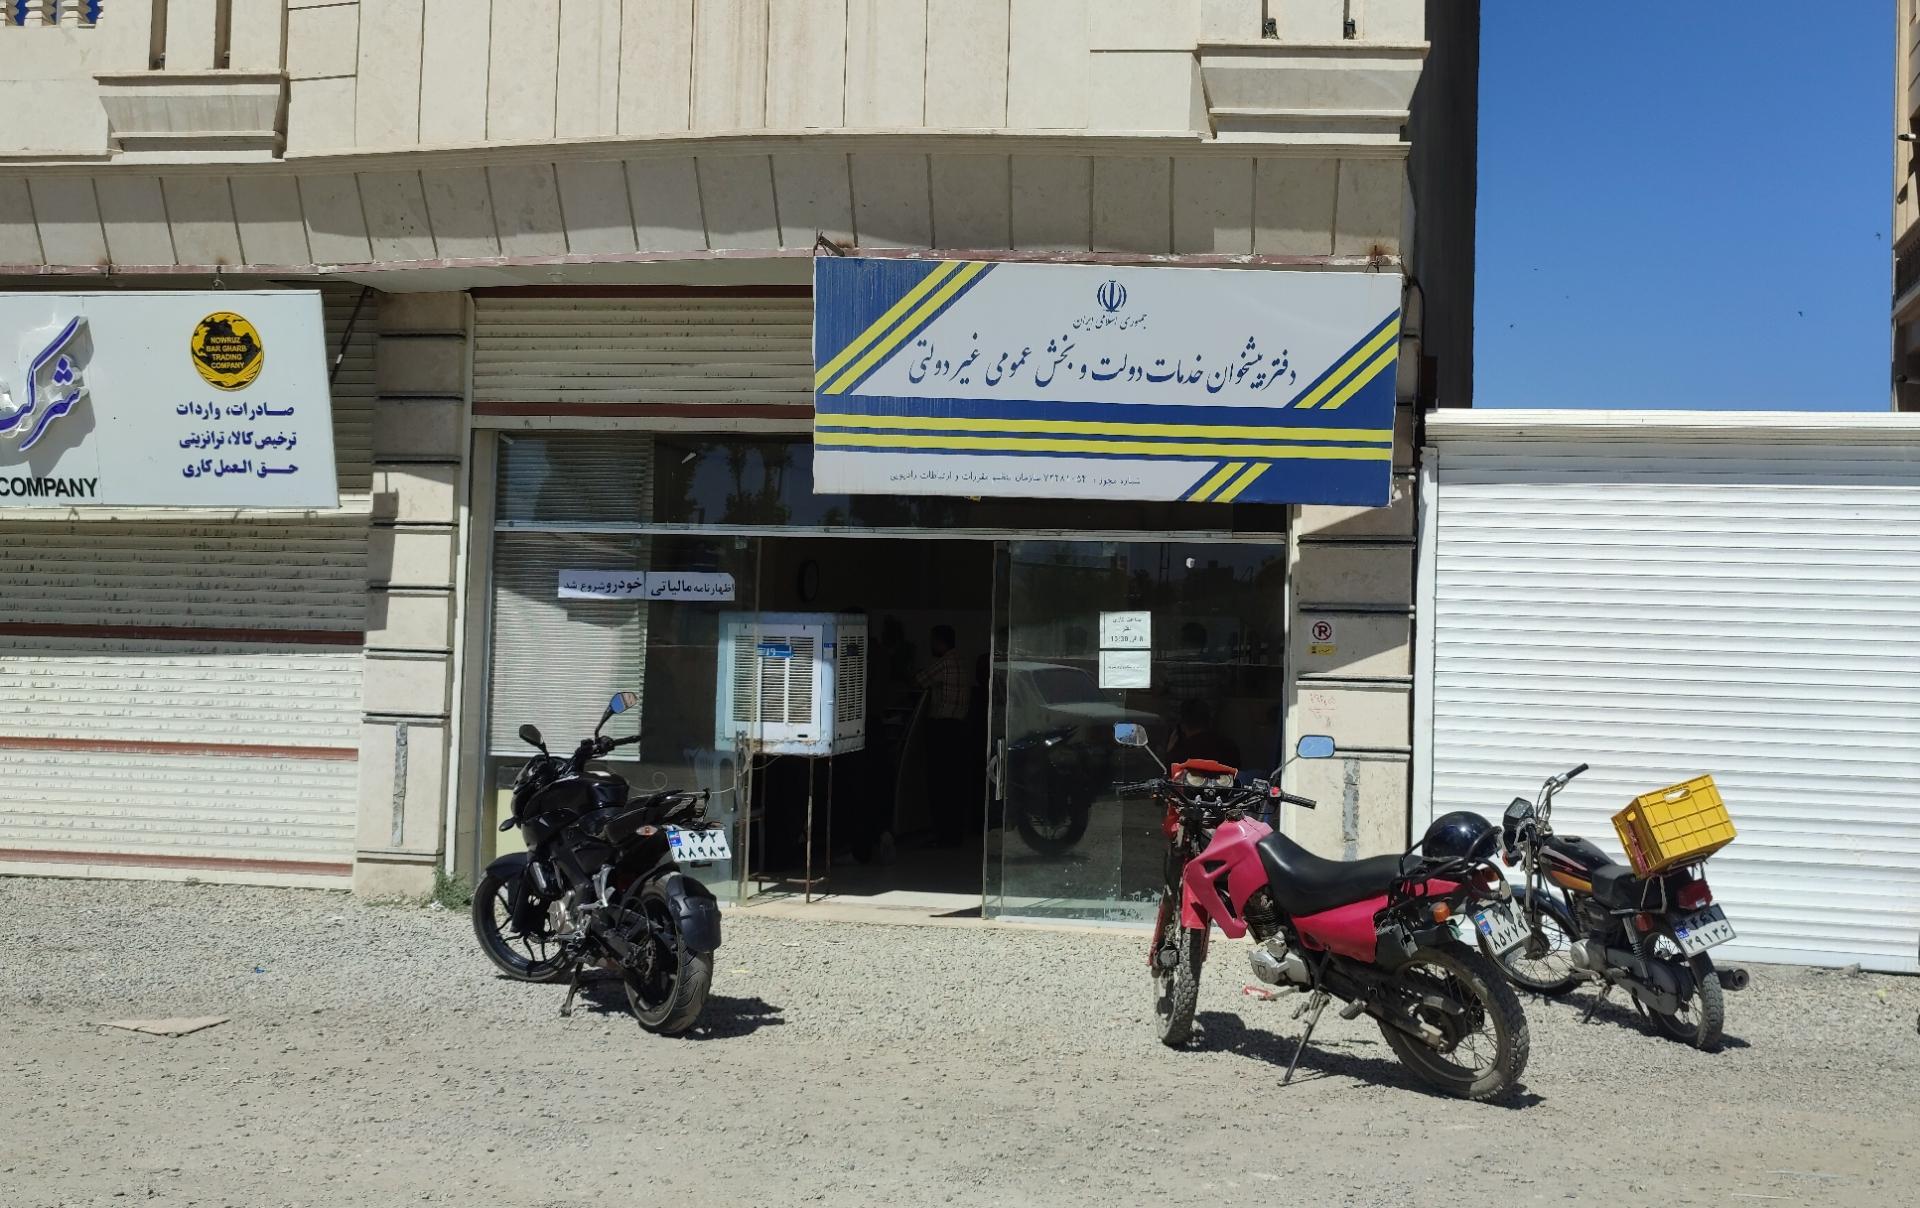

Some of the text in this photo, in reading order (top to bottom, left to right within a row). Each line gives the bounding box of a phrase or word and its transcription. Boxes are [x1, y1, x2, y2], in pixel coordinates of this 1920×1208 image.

[1072, 313, 1147, 331] جمهوری اسلامی ایران
[210, 361, 245, 369] COMPANY
[212, 353, 243, 361] TRADING
[908, 339, 950, 384] دولتی
[949, 331, 980, 384] غیر
[1035, 334, 1075, 387] بخش
[985, 347, 1031, 386] عمومی
[1078, 364, 1087, 379] و
[1091, 353, 1142, 381] دولت
[1146, 354, 1203, 384] خدمات
[176, 402, 221, 420] واردات
[179, 431, 225, 449] ترانزیتی
[255, 432, 297, 450] ترخیص
[182, 459, 298, 478] حق العمل کاری
[0, 477, 98, 497] COMPANY
[563, 580, 577, 590] شد
[606, 577, 643, 594] خودرو
[651, 578, 692, 596] مالیاتی
